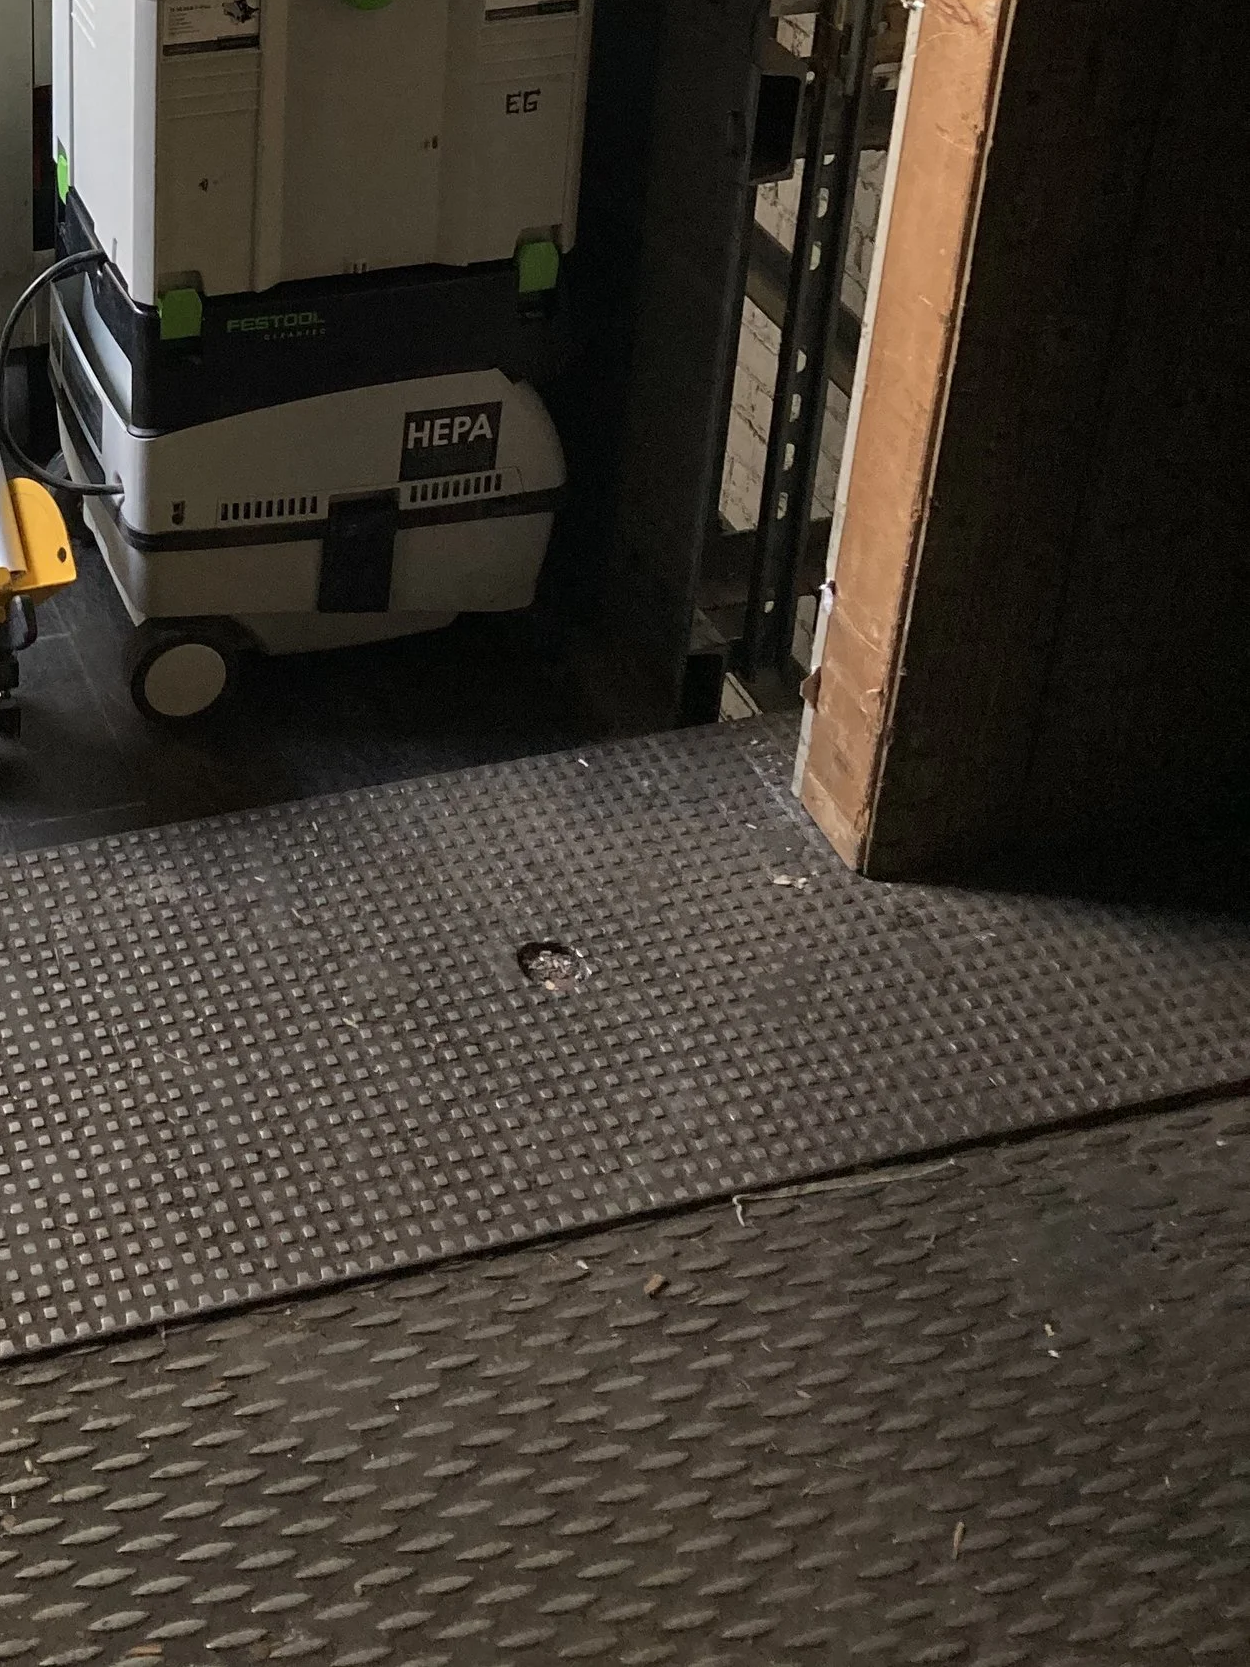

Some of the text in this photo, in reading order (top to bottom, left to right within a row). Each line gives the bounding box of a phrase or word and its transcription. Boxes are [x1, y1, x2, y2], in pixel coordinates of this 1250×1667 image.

[506, 88, 541, 114] EG
[227, 312, 325, 333] FESTOOL
[407, 413, 493, 449] HEPA
